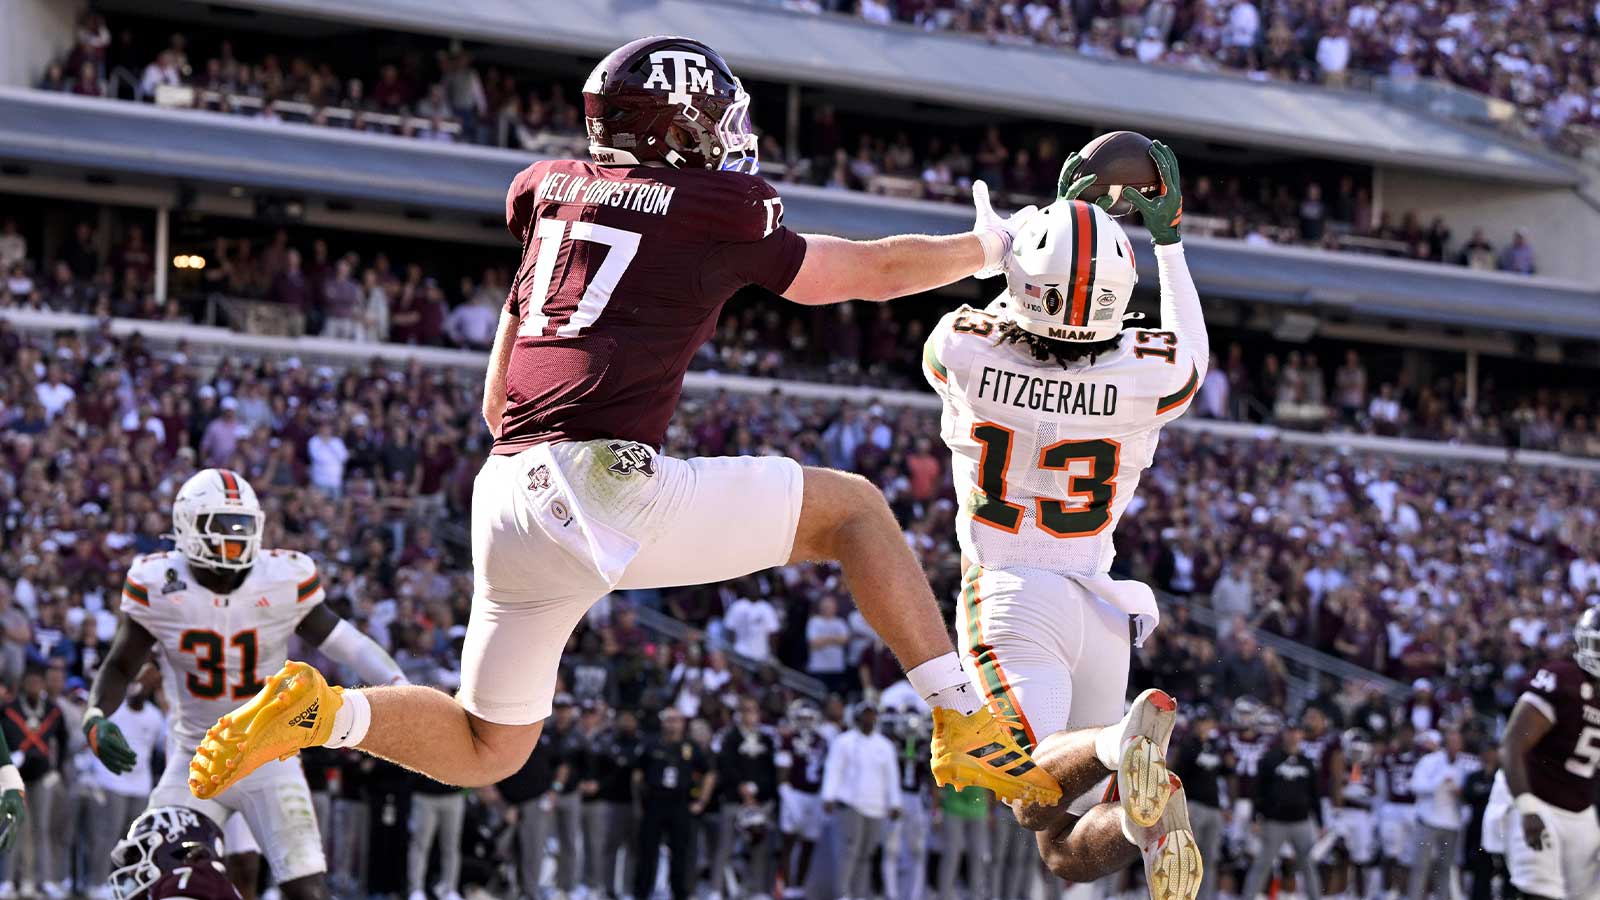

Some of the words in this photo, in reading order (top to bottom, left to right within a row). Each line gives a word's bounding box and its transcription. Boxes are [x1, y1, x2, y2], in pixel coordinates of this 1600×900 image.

[518, 218, 643, 338] 17
[1048, 327, 1096, 340] MIAMI
[1134, 330, 1178, 365] 13
[978, 366, 1118, 416] FITZGERALD
[969, 421, 1121, 539] 13
[180, 629, 265, 701] 31
[1564, 726, 1600, 779] 5
[173, 867, 193, 889] 7
